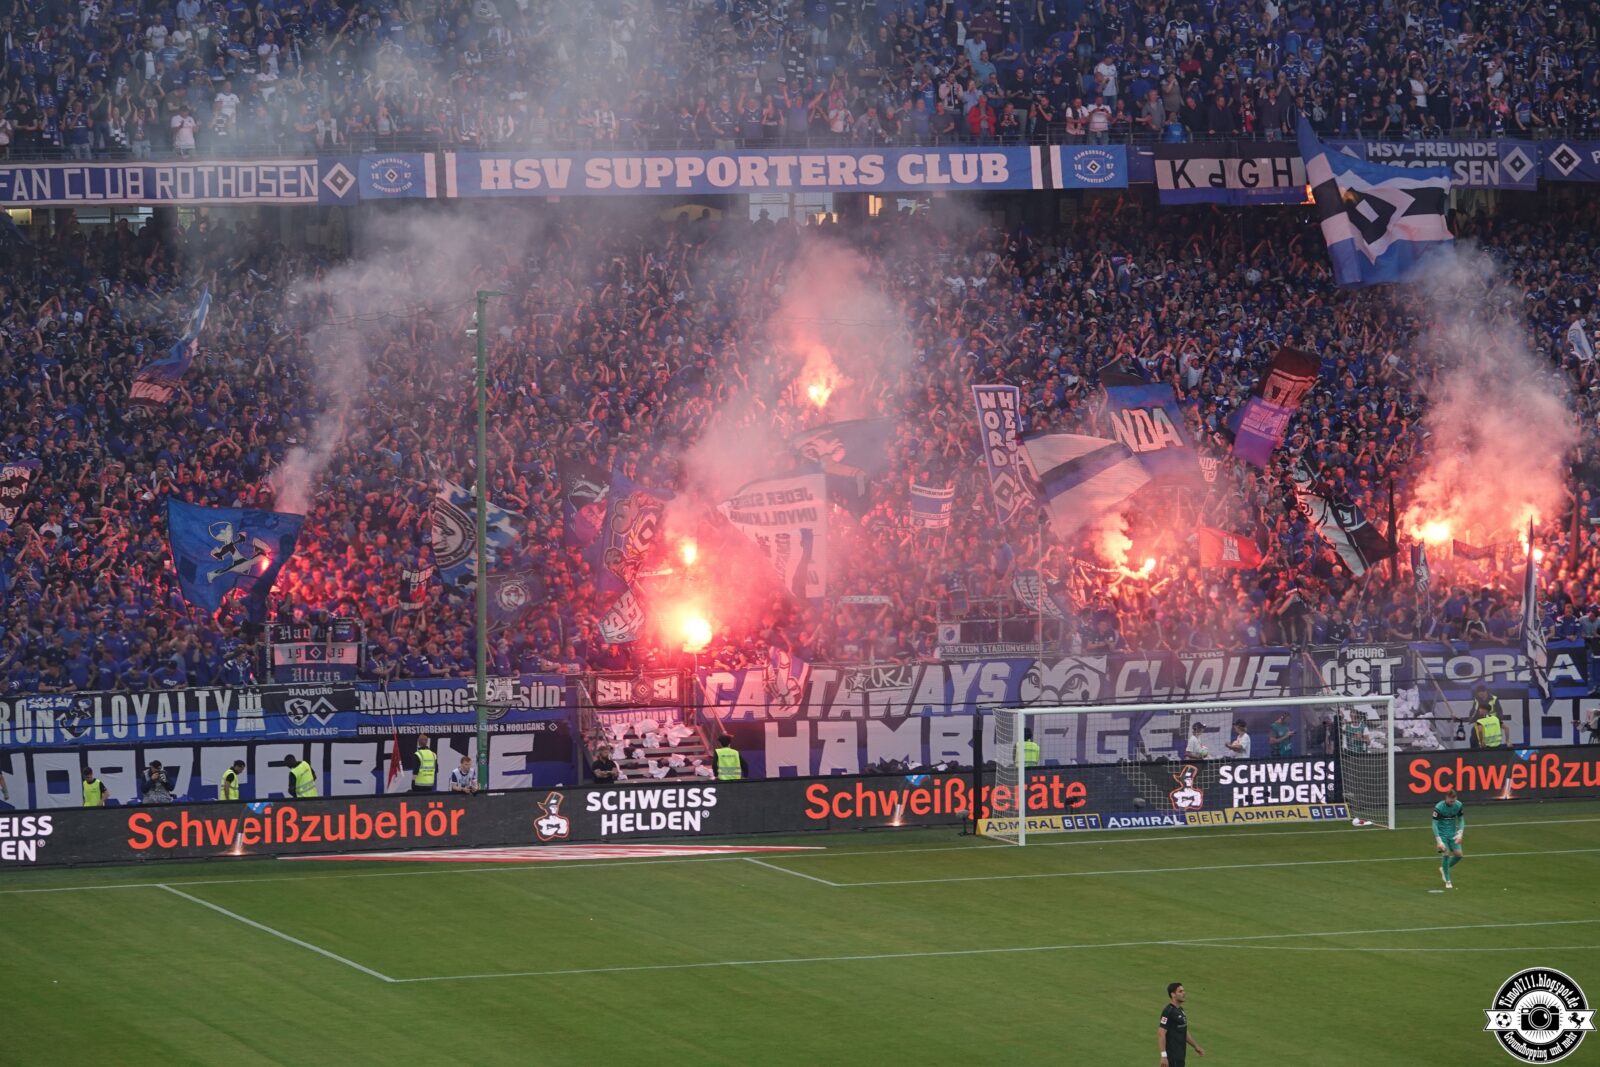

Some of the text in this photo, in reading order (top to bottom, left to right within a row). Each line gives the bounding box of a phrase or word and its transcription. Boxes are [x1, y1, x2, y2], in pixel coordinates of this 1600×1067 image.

[1367, 142, 1498, 157] HSV-FREUNDE
[64, 167, 145, 200] CLUB
[156, 164, 318, 199] ROTHOSEN
[480, 153, 1009, 190] HSV SUPPORTERS CLUB
[979, 391, 1008, 467] NORD
[944, 643, 1041, 654] SEKTION STADIONVERBO
[288, 687, 333, 696] HAMBURG
[703, 658, 1012, 720] CATAWAYS
[1322, 657, 1403, 697] OST
[94, 689, 231, 740] LOYALTY
[359, 681, 561, 715] HAMBURG SÜD
[288, 727, 338, 737] HOOLIGANS
[1218, 761, 1334, 785] SCHWEISS
[1408, 753, 1600, 795] Schweißzu
[586, 787, 717, 811] SCHWEISS
[804, 775, 1087, 820] Schweißgeräte
[1232, 806, 1346, 823] ADMIRAL BET
[127, 802, 465, 850] Schweißzubehör
[1063, 814, 1099, 829] BET
[1108, 811, 1223, 829] ADMIRAL BET
